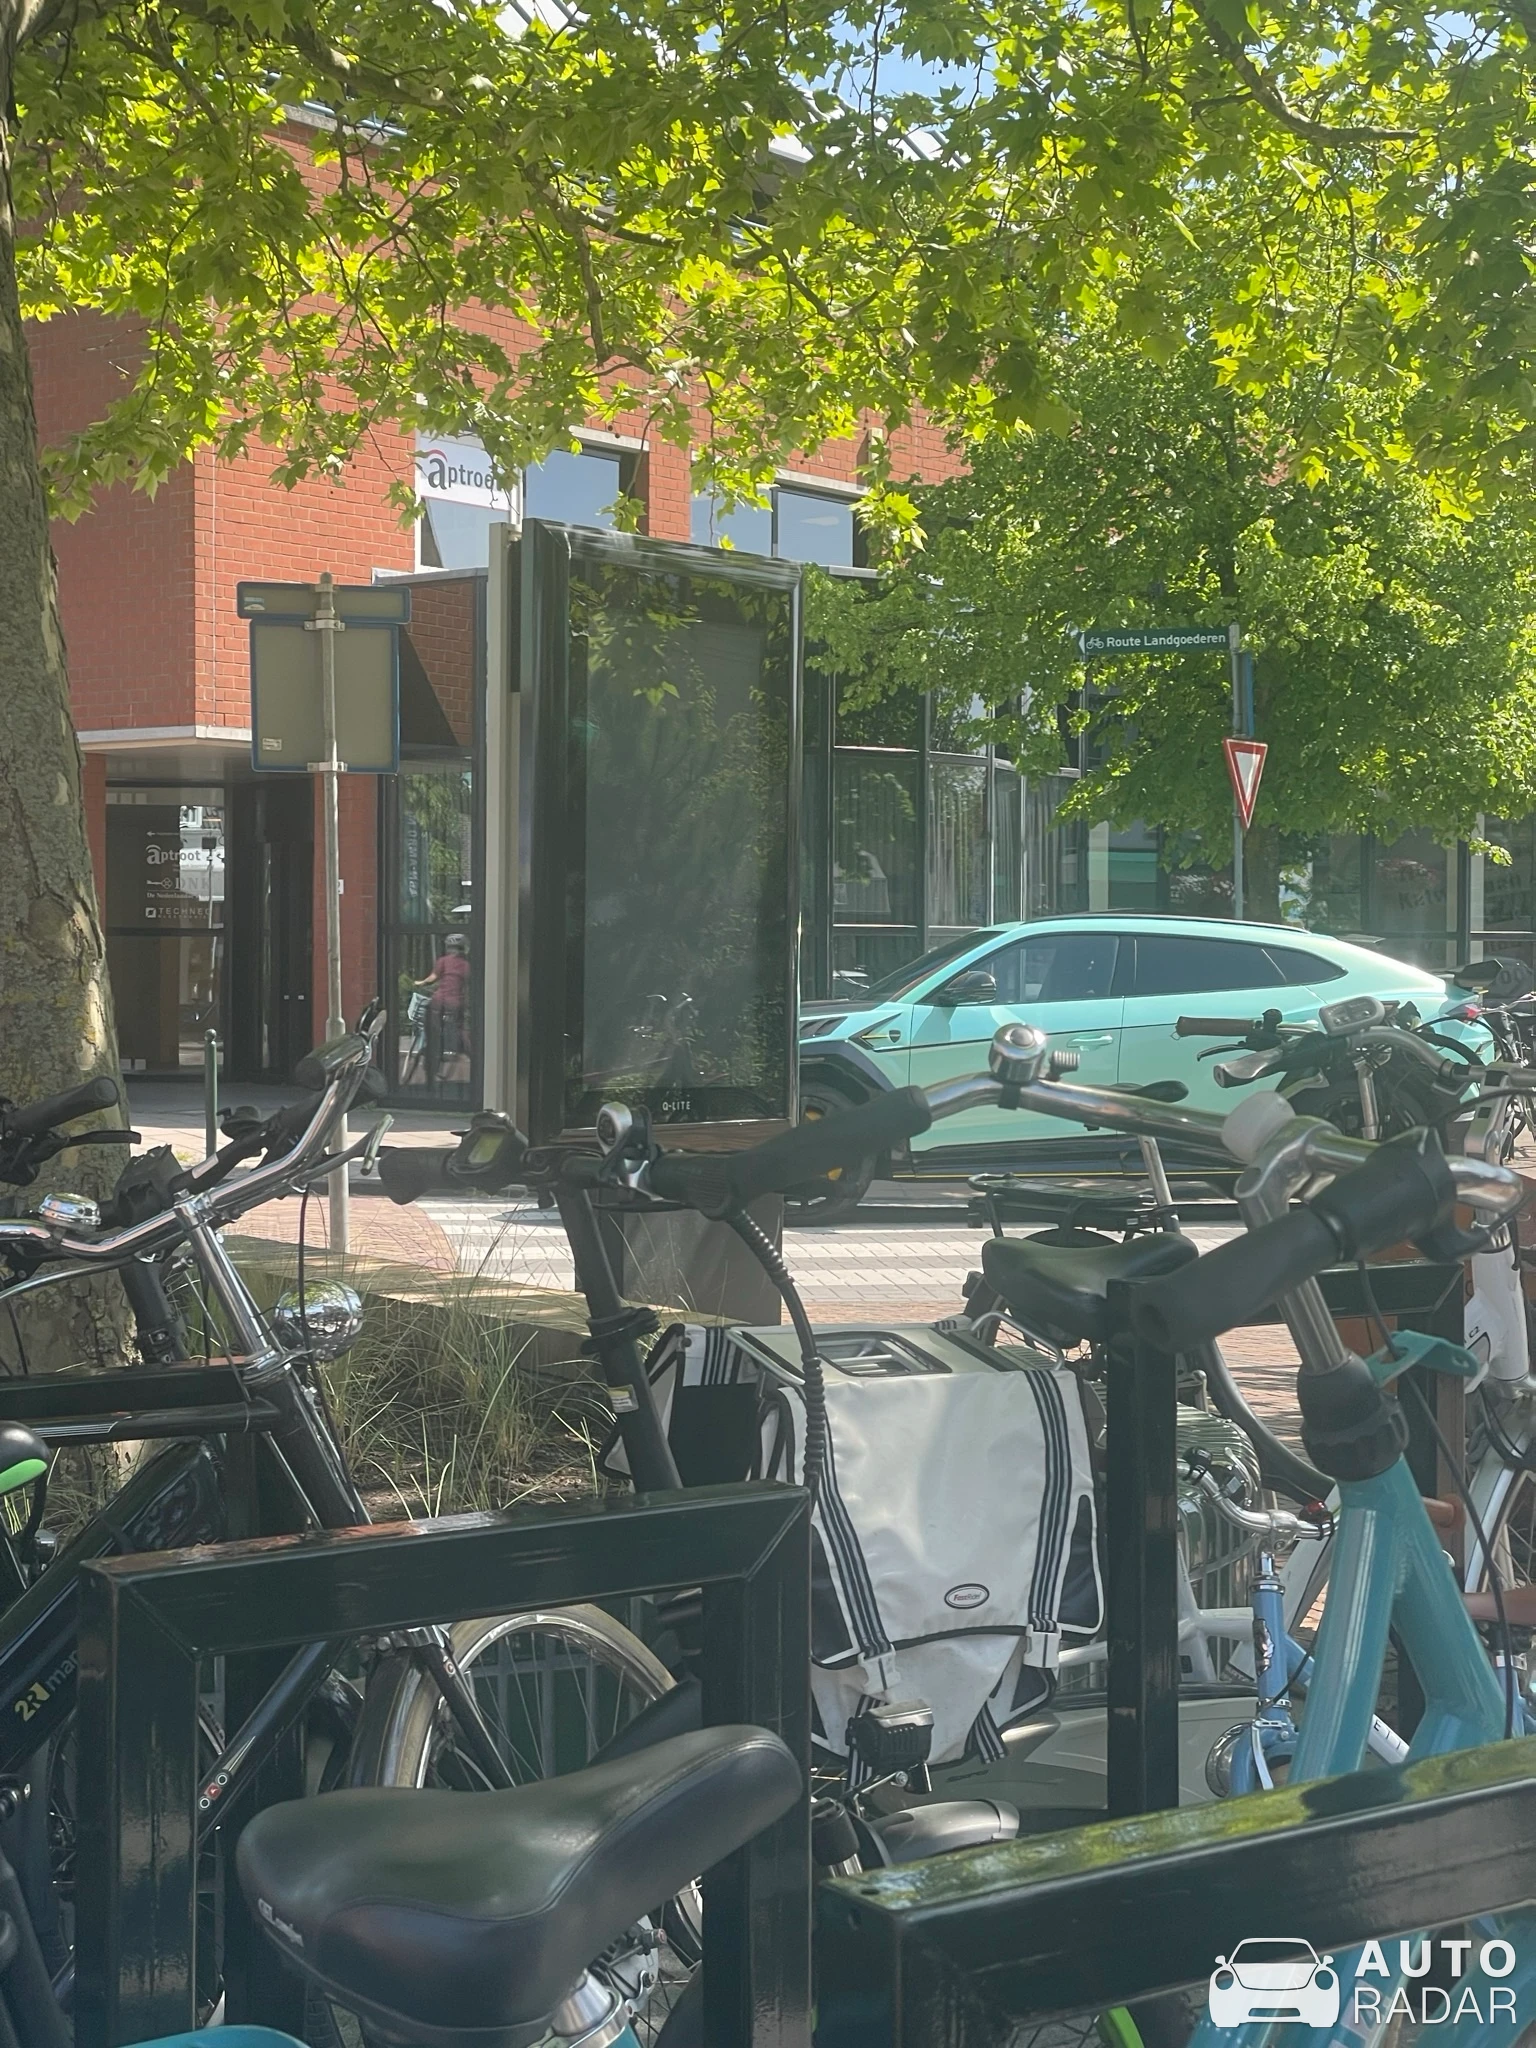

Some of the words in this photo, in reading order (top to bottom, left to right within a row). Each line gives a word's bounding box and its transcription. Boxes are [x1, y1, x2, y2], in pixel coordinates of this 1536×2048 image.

[1106, 636, 1141, 647] Route
[1144, 633, 1226, 648] Landgoederen
[146, 847, 201, 864] aptroot
[662, 1101, 691, 1111] Q-LITE
